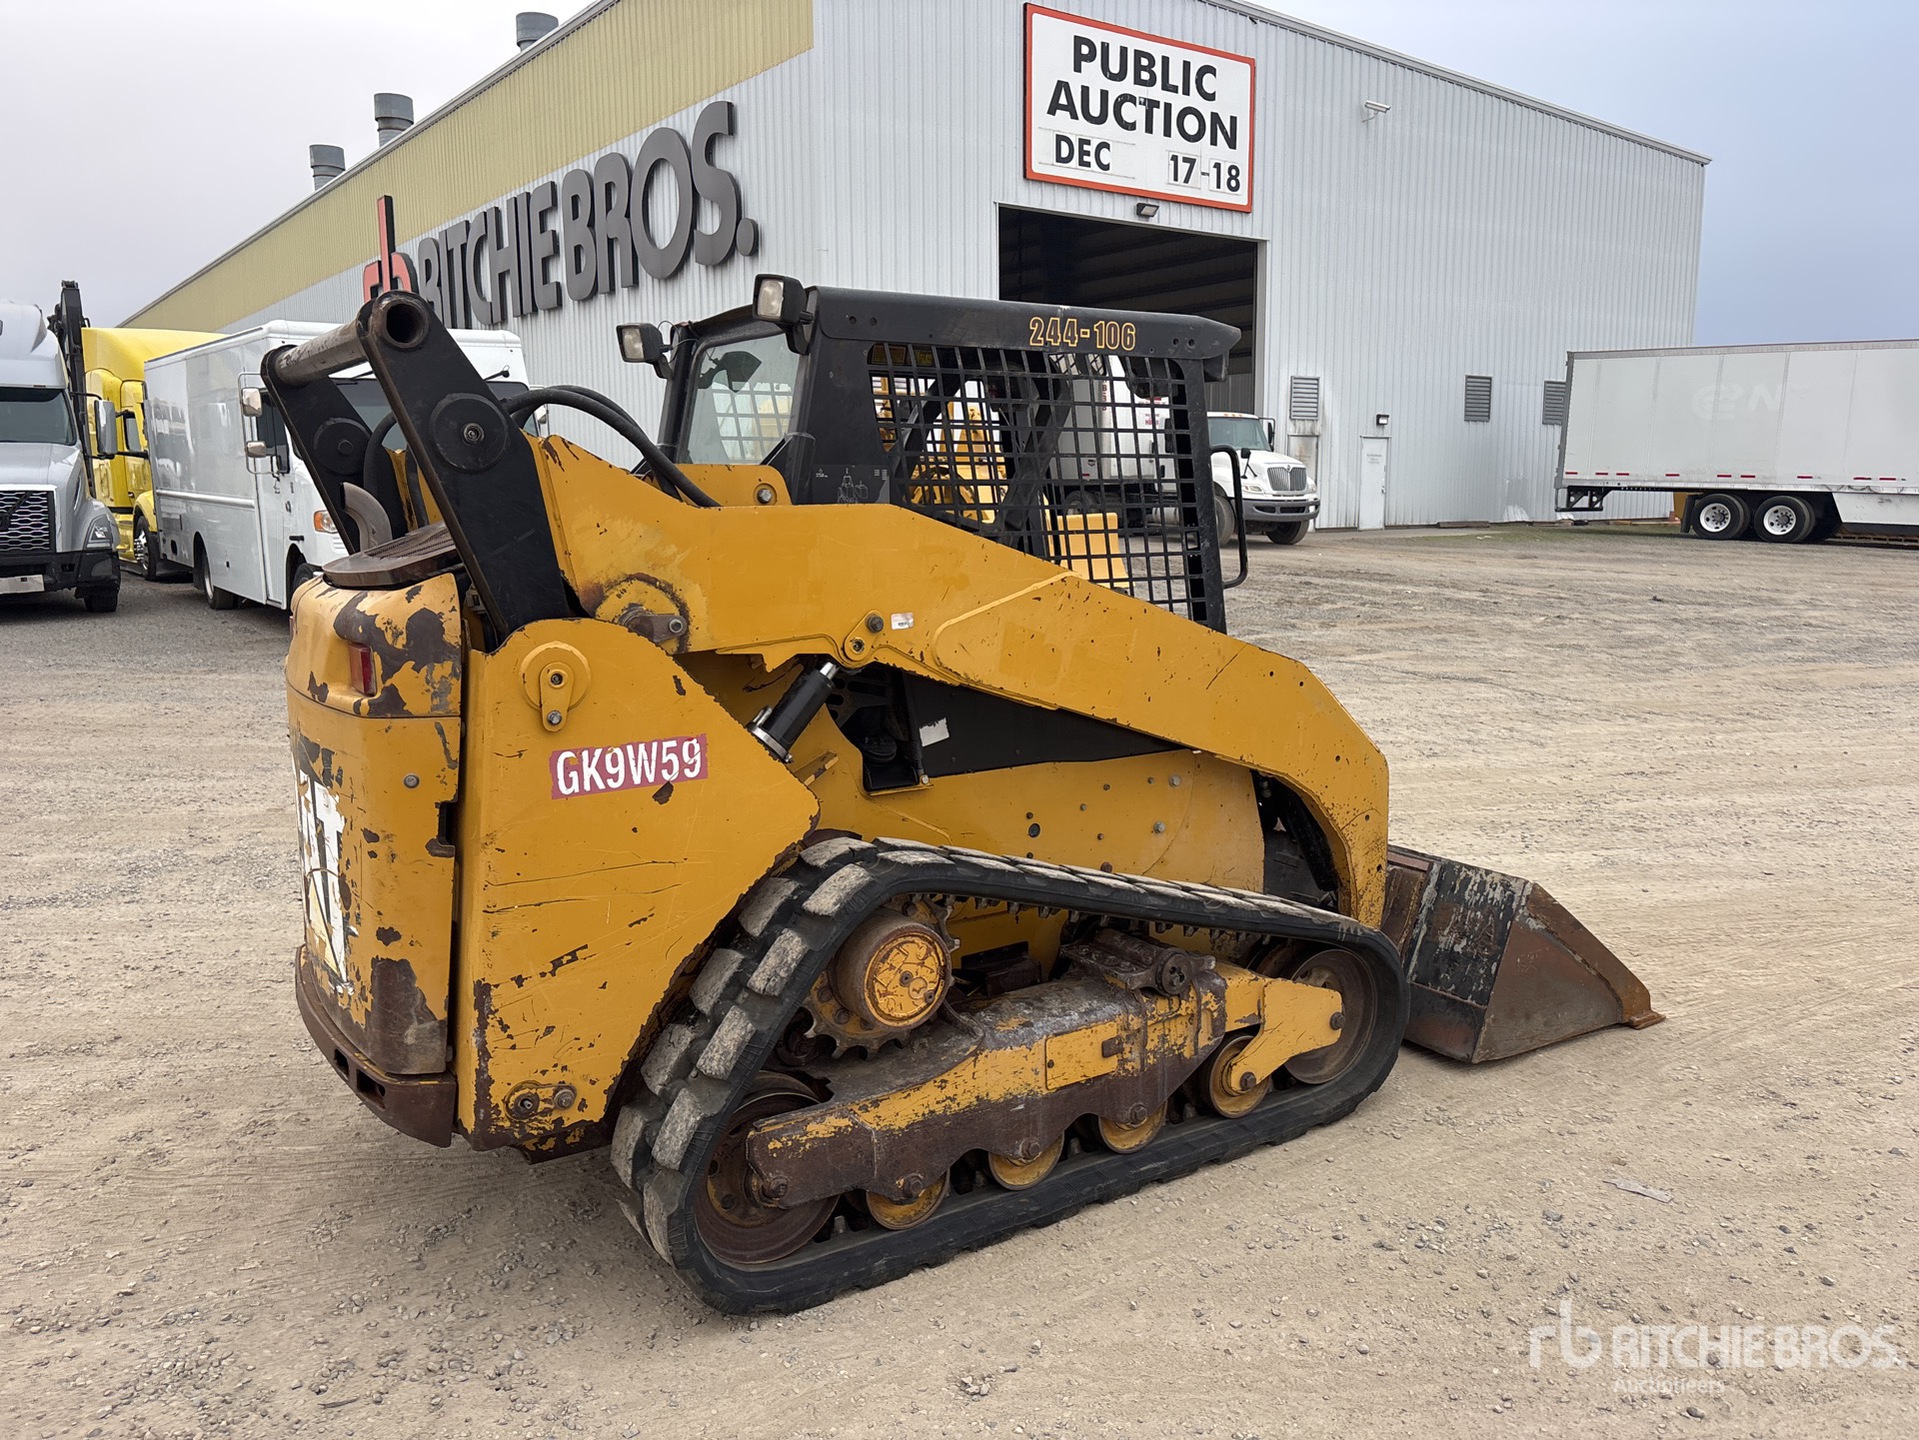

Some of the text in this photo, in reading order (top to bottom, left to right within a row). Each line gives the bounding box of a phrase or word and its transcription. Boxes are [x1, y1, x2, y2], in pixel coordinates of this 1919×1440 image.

[1073, 35, 1217, 102] PUBLIC
[1047, 79, 1238, 151] AUCTION
[1055, 133, 1241, 192] DEC 17-18
[418, 181, 562, 329] RITCHIE
[561, 101, 759, 301] BROS.
[1029, 317, 1136, 351] 244-106
[556, 737, 702, 796] GK9W59
